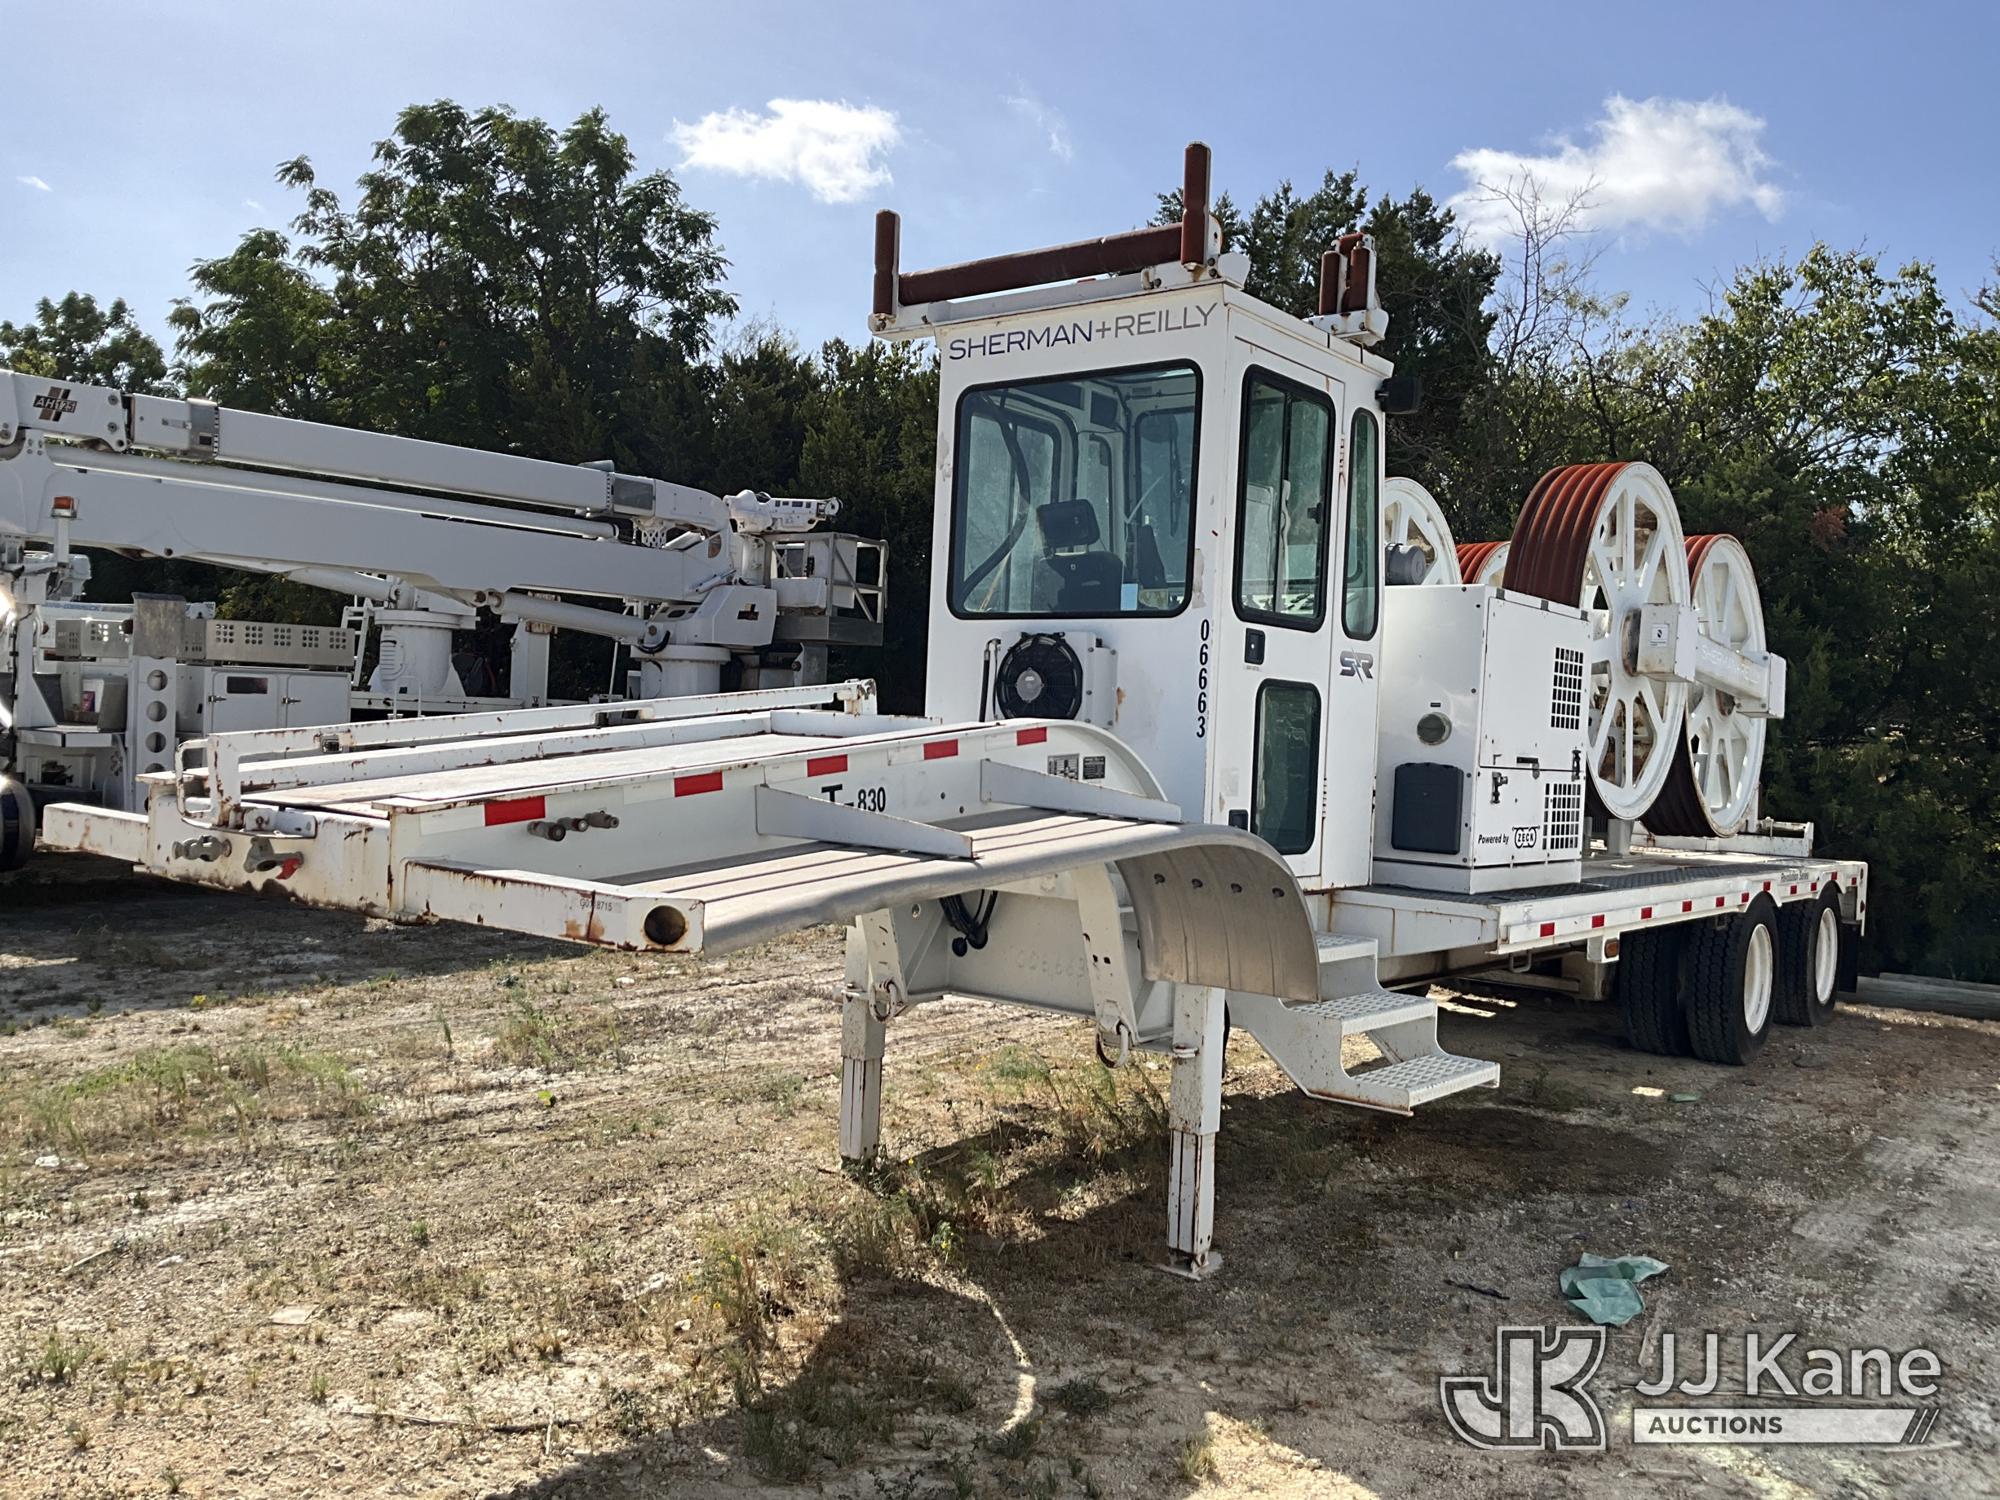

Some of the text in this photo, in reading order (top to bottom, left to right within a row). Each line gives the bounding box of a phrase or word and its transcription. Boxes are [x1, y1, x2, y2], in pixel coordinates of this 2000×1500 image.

[949, 302, 1218, 361] SHERMAN+REILLY
[1196, 619, 1210, 738] 06663
[1478, 833, 1510, 845] Powered by
